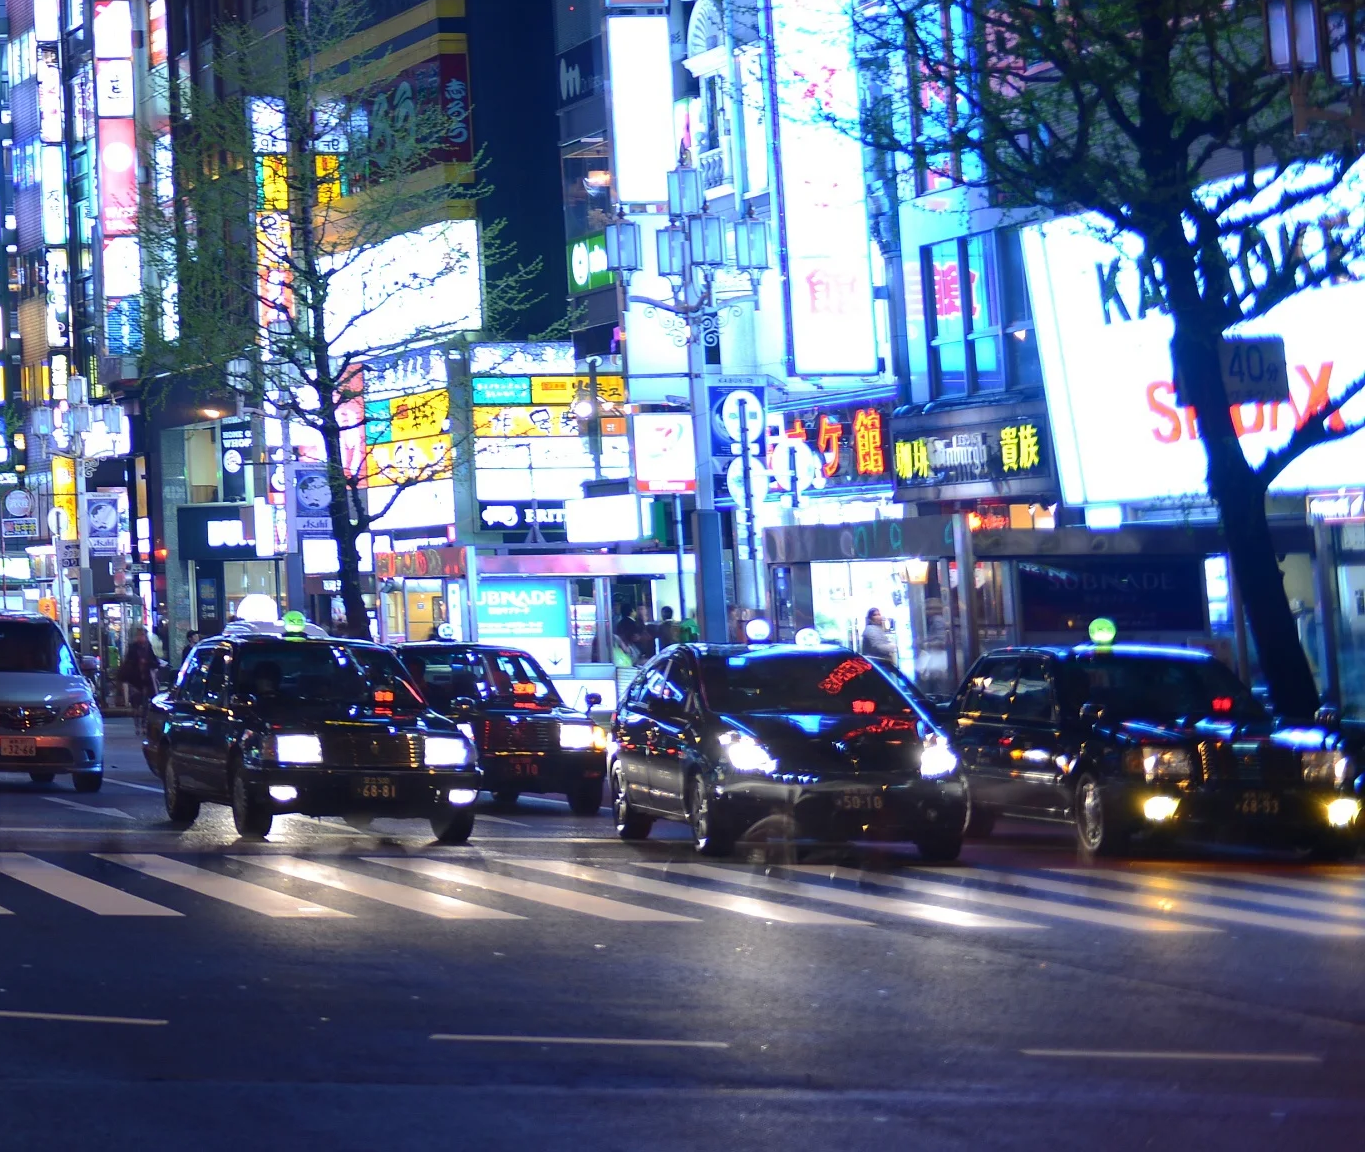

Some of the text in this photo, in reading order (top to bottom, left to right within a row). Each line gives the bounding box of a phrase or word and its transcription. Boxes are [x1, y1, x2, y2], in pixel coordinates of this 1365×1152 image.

[1228, 345, 1279, 385] 40分
[999, 423, 1040, 473] 貴族
[92, 538, 115, 548] Asahi
[8, 744, 35, 755] 32-66
[362, 784, 397, 797] 68-81
